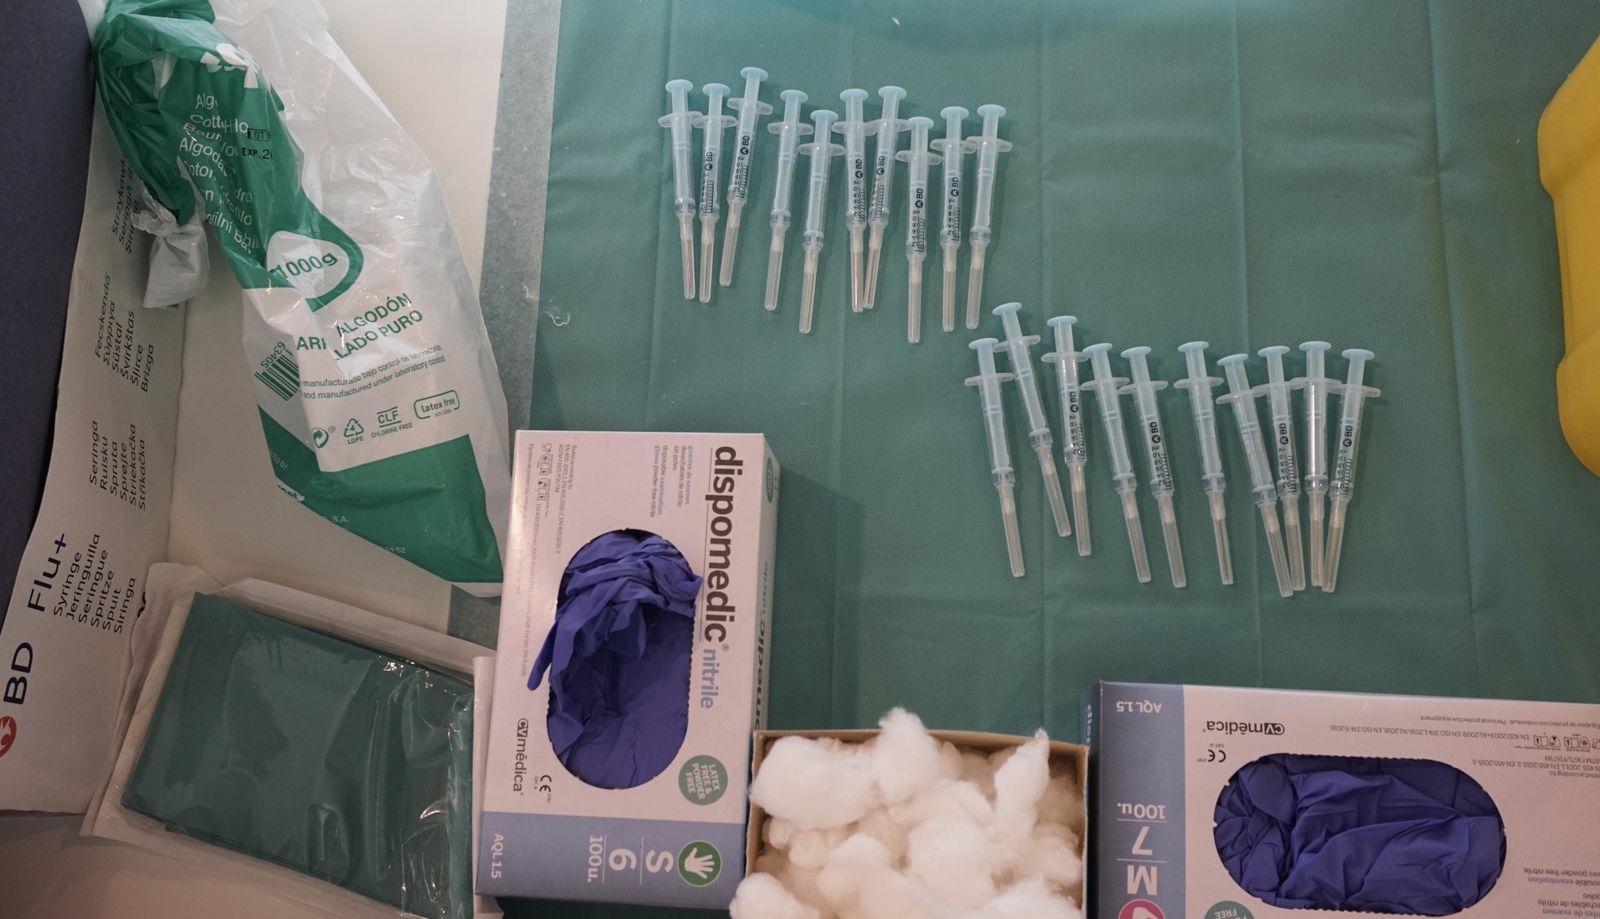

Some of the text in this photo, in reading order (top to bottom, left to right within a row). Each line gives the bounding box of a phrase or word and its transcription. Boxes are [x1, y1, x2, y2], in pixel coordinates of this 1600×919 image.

[336, 292, 412, 338] ALGODÓN
[379, 310, 423, 337] PURO
[141, 344, 154, 392] Brizga
[377, 410, 399, 424] CLF
[421, 401, 443, 413] latex
[90, 420, 99, 485] Seringa
[100, 436, 108, 490] Ruisku
[110, 441, 119, 496] Spruta
[53, 552, 82, 616] Syringe
[65, 534, 100, 620] Jeringuilla
[78, 550, 108, 624] Seringue
[90, 571, 115, 627] Spritze
[700, 446, 744, 709] dispomedic nitrile
[3, 533, 67, 705] BD Flu+
[102, 589, 121, 631] Spuit
[113, 578, 136, 634] Siringa
[1116, 700, 1162, 714] AQL 1.5
[685, 772, 697, 794] FREE
[691, 763, 706, 800] POWDER
[700, 765, 712, 786] FREE
[709, 764, 720, 792] LATEX
[491, 833, 505, 879] AQL 1.5
[608, 848, 637, 871] 6
[645, 850, 674, 874] S
[1132, 826, 1152, 856] 7
[1127, 864, 1158, 896] M
